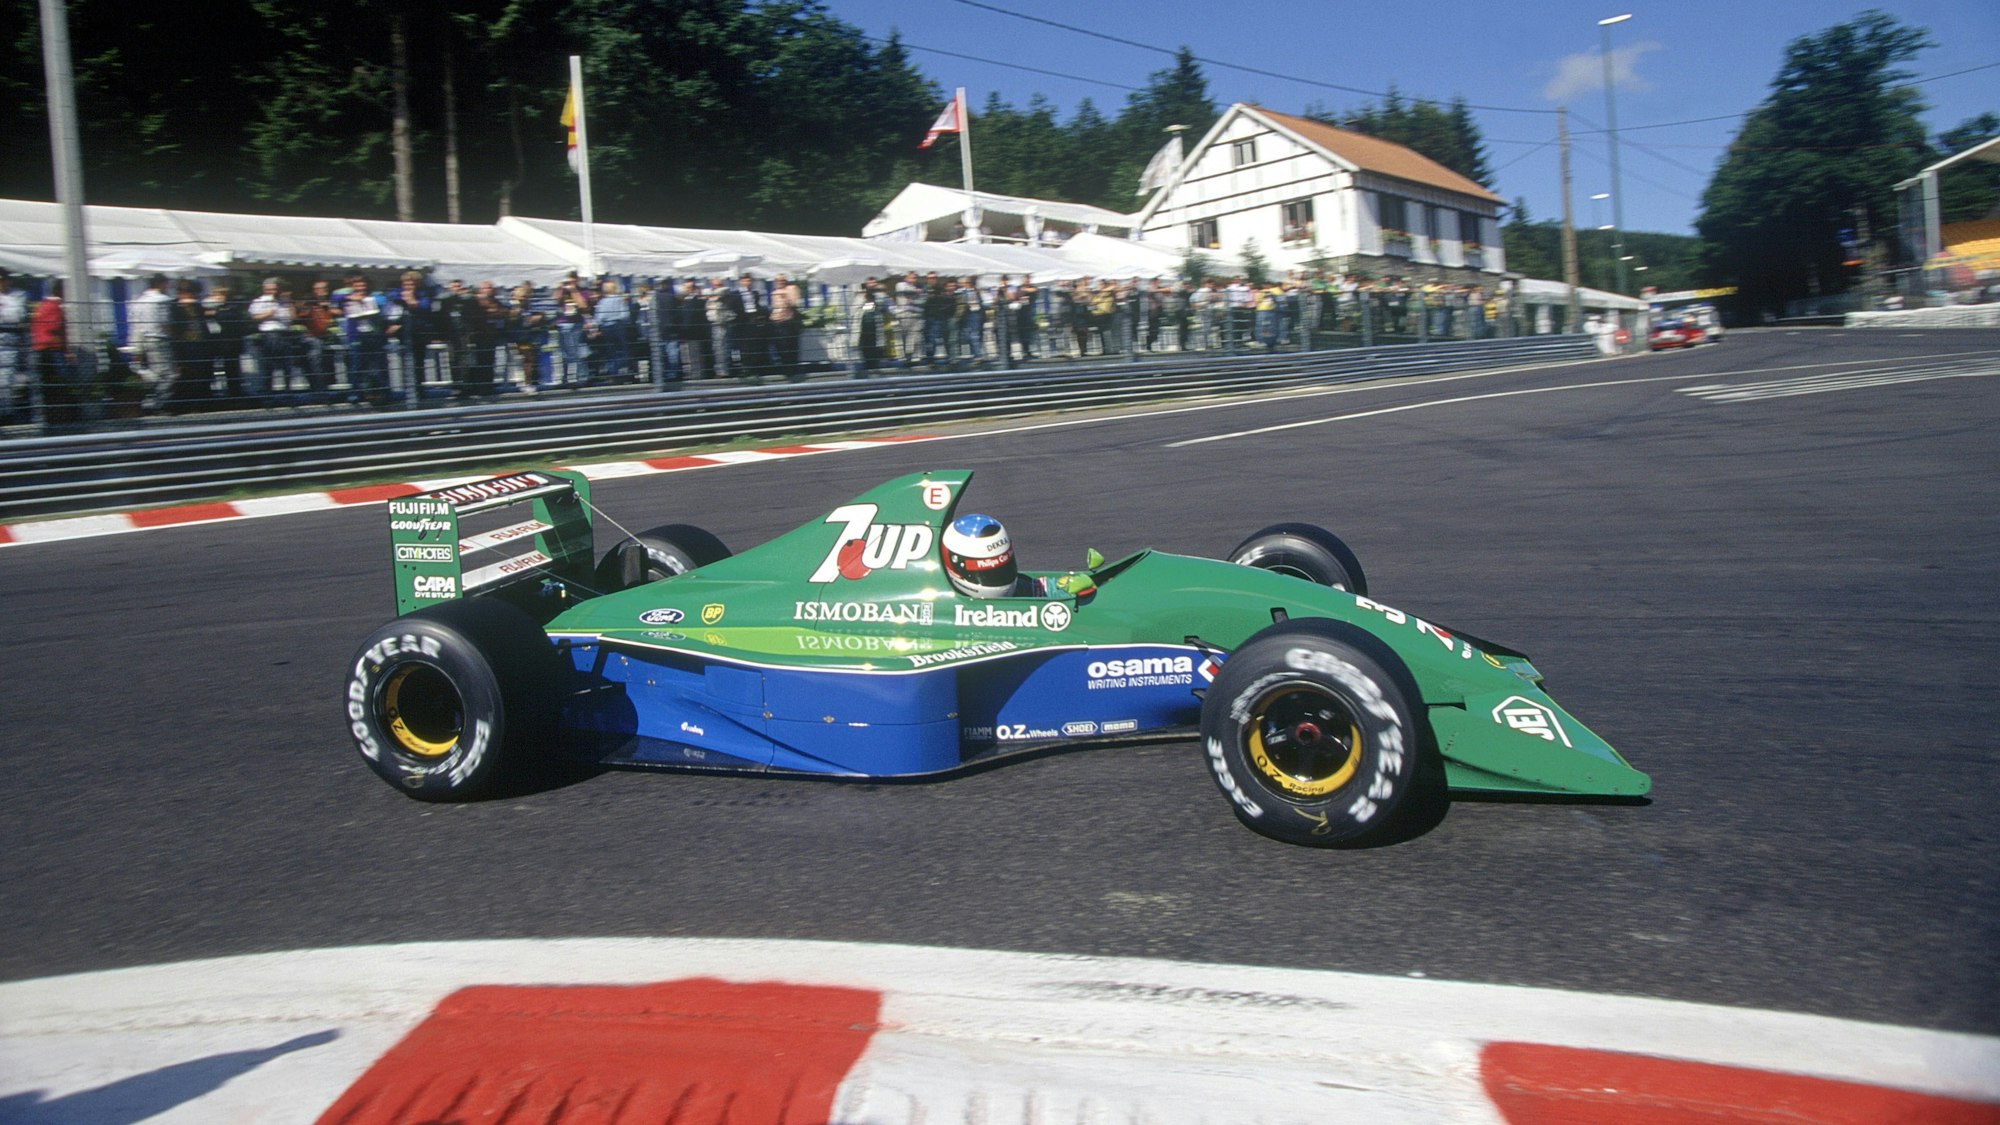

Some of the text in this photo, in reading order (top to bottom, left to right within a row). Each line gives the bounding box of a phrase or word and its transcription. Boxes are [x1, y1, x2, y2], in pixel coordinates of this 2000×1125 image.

[930, 487, 943, 505] E
[389, 502, 449, 515] FUJIFILM
[807, 503, 933, 583] 7UP
[413, 576, 456, 592] CAPA
[646, 610, 677, 622] Ford
[704, 607, 722, 619] BP
[793, 601, 920, 624] ISMOBAN
[954, 604, 1038, 628] Ireland
[908, 641, 1017, 667] Brooksfield
[1087, 656, 1192, 678] osama
[1088, 673, 1193, 690] WRITING INSTRUMENTS
[1067, 722, 1094, 733] SHOEI
